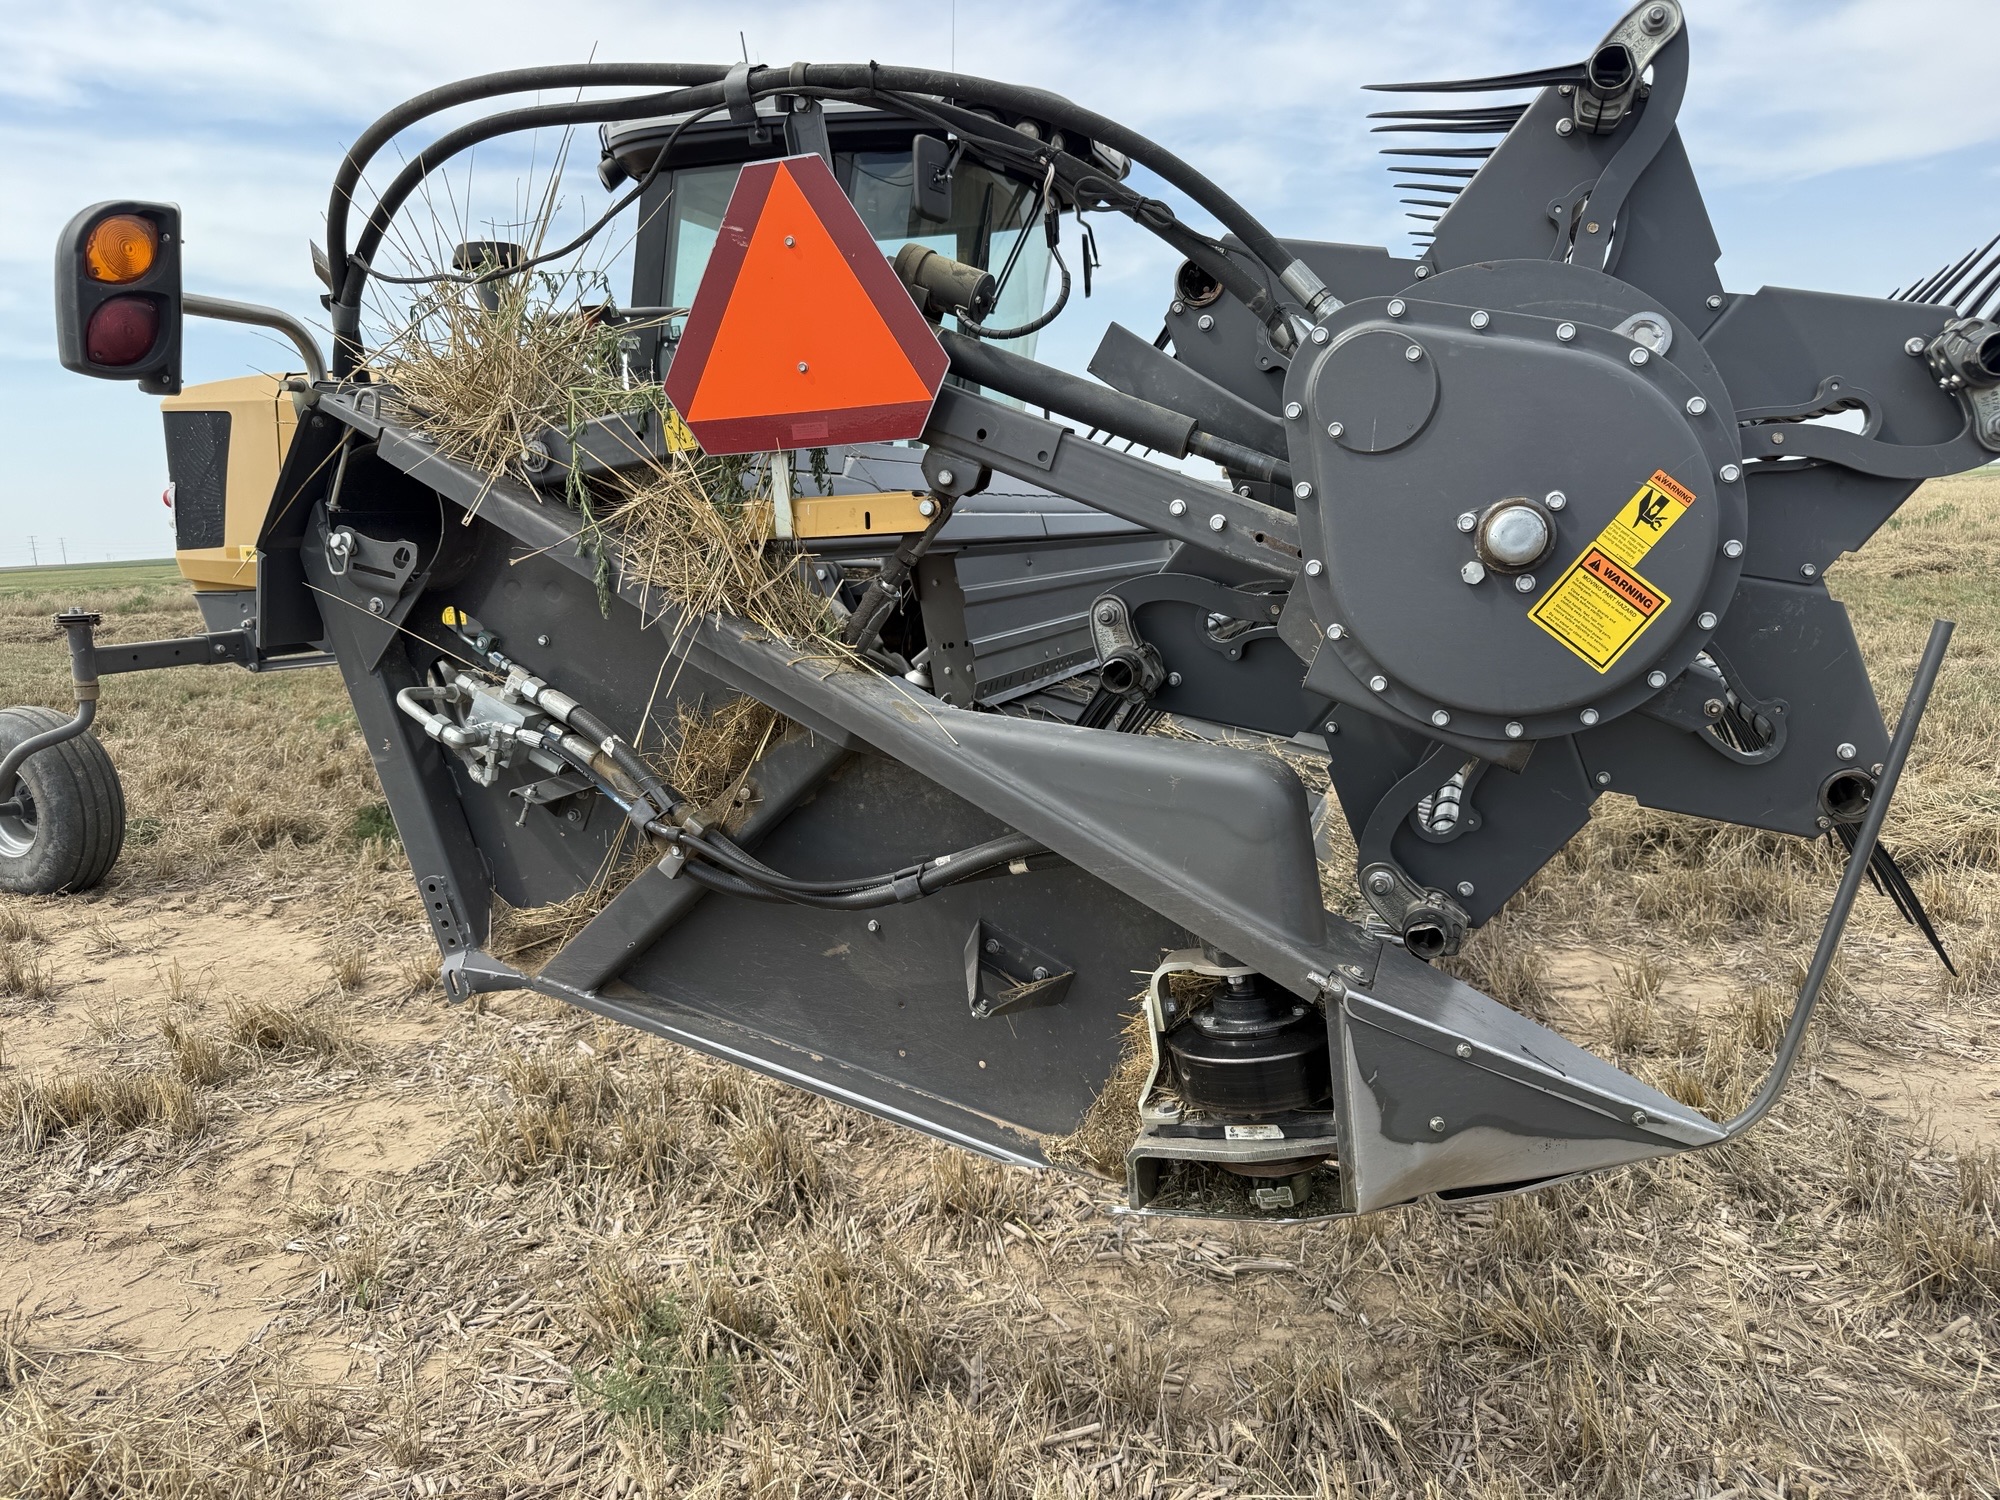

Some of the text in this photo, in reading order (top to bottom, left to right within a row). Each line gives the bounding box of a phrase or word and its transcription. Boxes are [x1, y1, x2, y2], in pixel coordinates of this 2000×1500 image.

[1660, 478, 1693, 503] WARNING
[1570, 588, 1580, 597] Close
[1602, 567, 1654, 609] WARNING
[1582, 574, 1637, 618] MOVING PART HAZARD
[1579, 600, 1591, 610] before
[1564, 616, 1575, 625] before
[1589, 622, 1603, 633] moving
[1591, 632, 1603, 642] power
